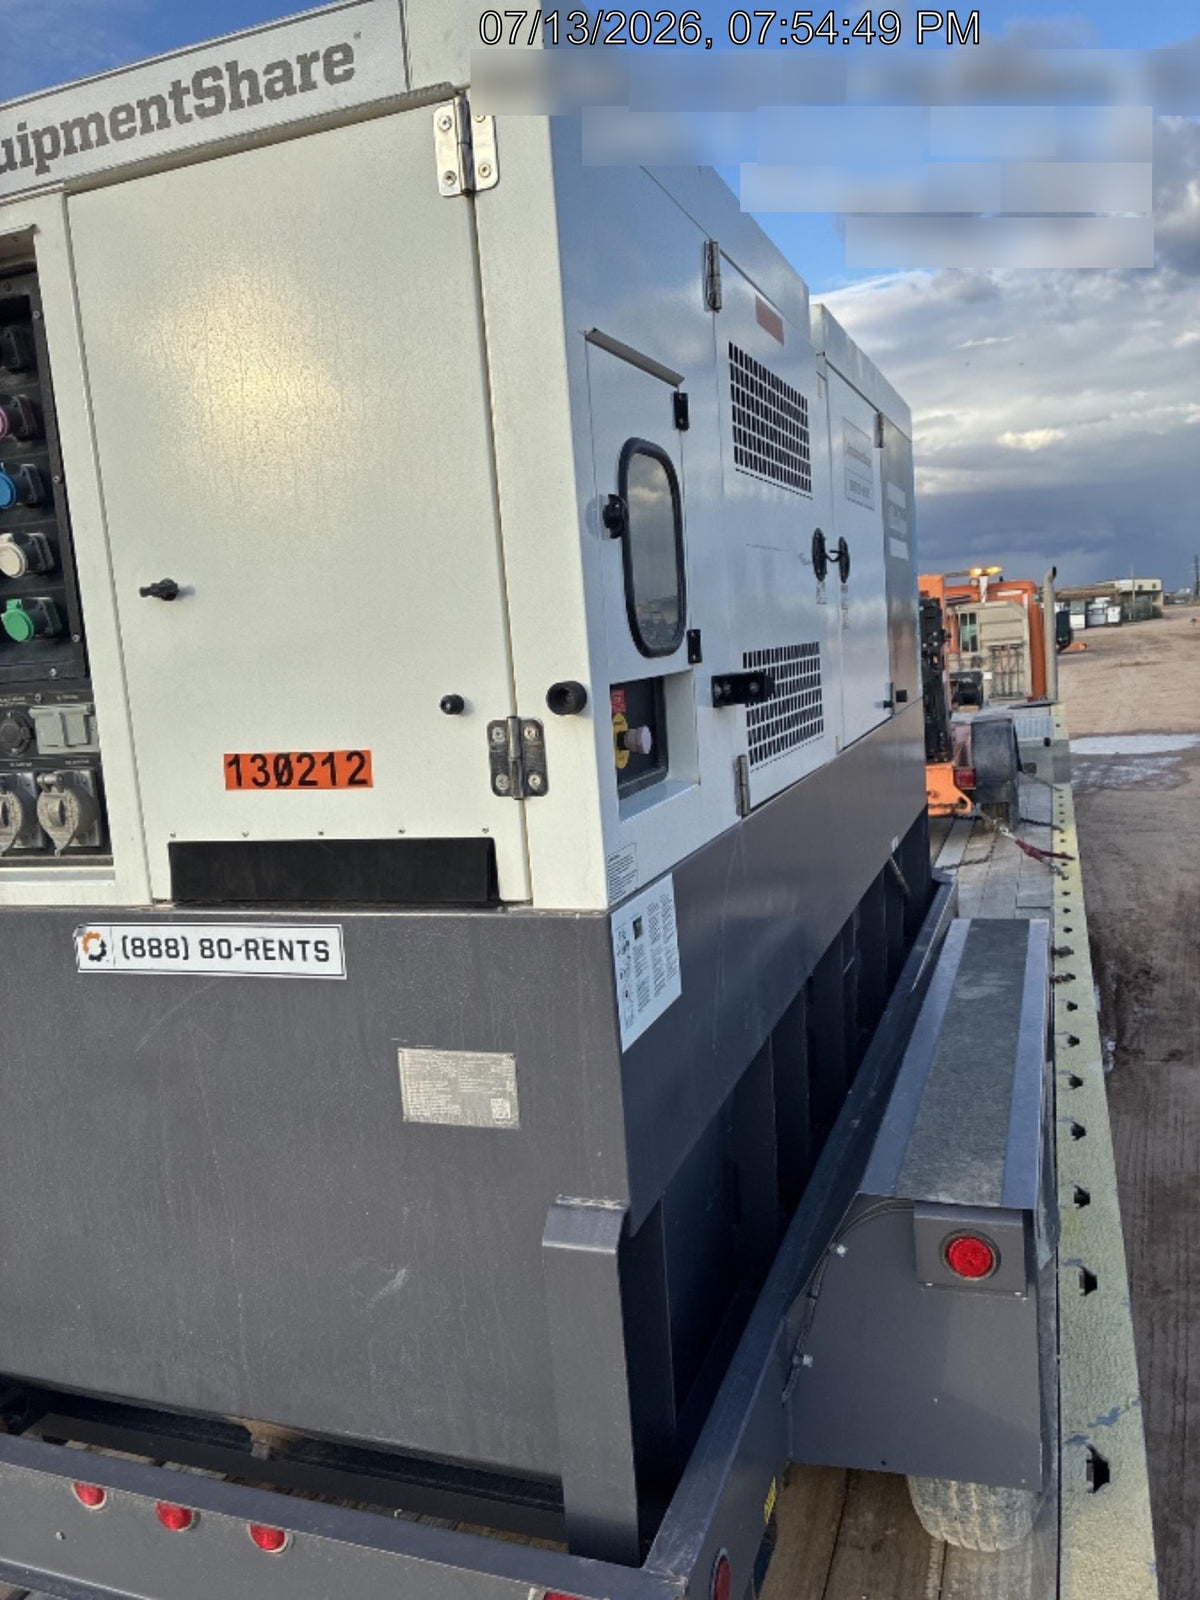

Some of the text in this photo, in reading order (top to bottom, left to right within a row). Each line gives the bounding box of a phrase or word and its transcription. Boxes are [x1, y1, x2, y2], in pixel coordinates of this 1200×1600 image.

[227, 750, 368, 787] 130212
[121, 934, 330, 963] (888) 80-RENTS
